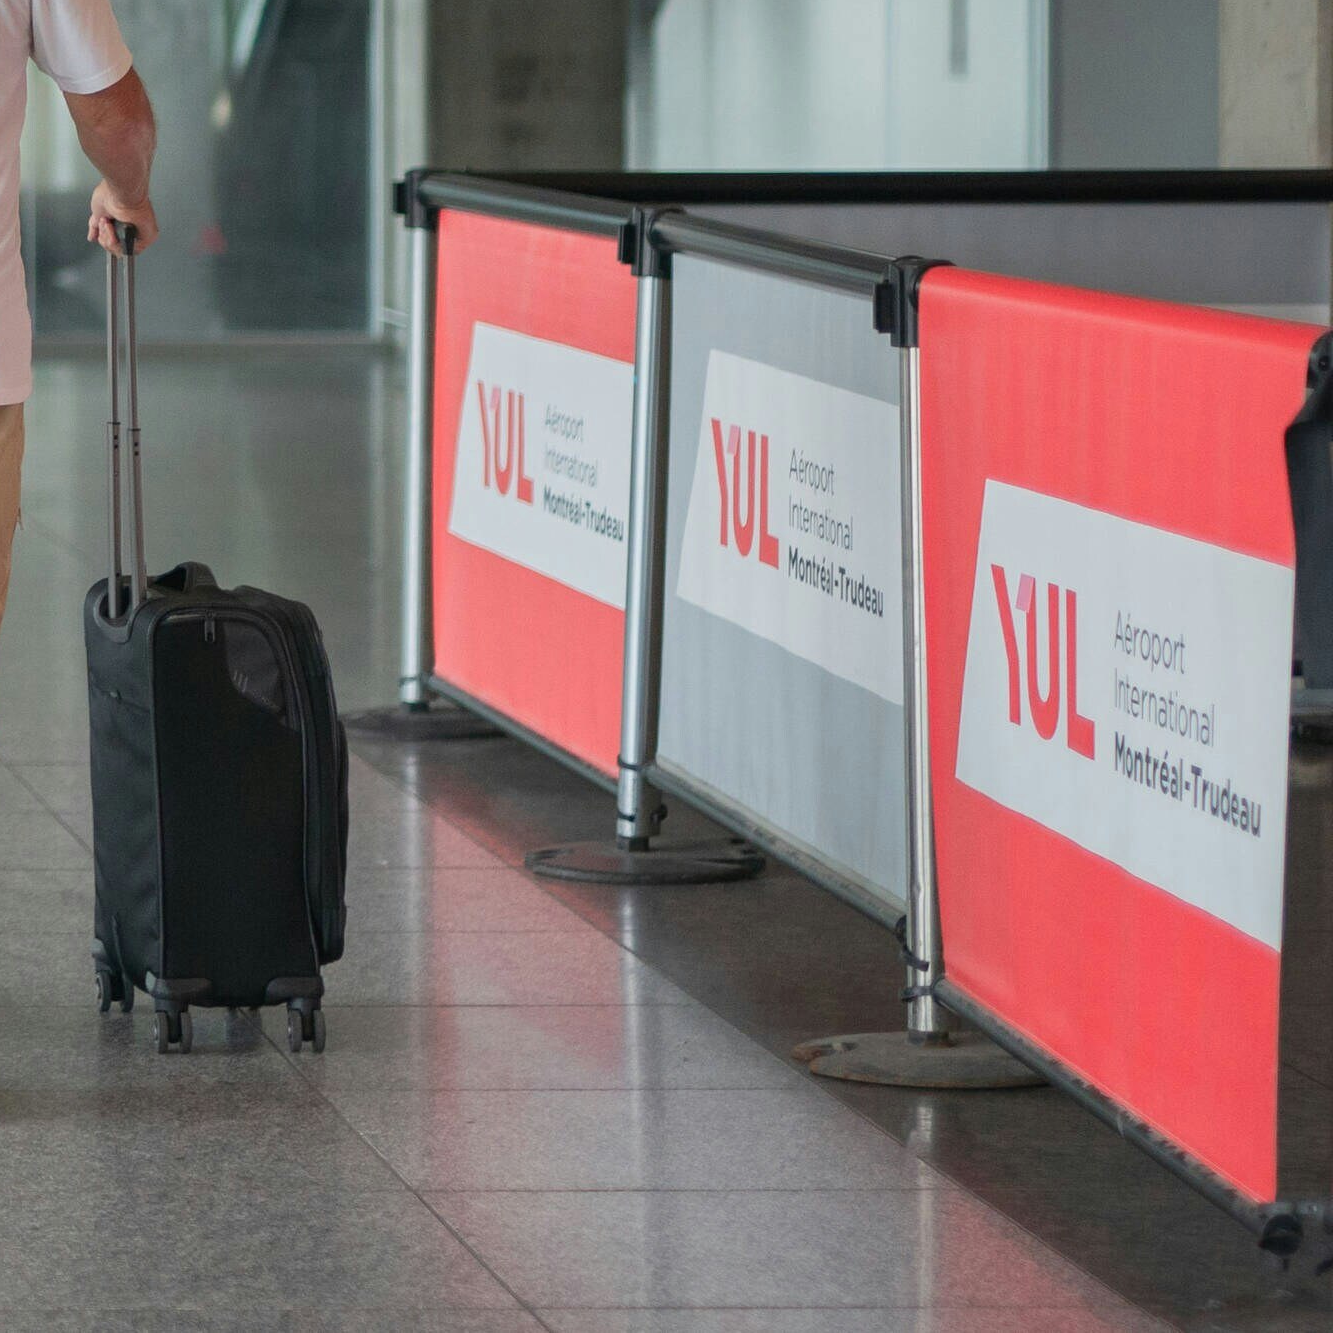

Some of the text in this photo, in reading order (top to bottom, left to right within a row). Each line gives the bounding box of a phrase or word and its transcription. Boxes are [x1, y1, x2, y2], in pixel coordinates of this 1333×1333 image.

[477, 380, 534, 505] YUL
[789, 448, 835, 496] Aéroport
[543, 484, 625, 543] Montréal-Trudeau
[711, 418, 780, 570] YUL
[789, 495, 854, 552] International
[788, 545, 884, 618] Montréal-Trudeau
[991, 563, 1095, 761] YUL
[1113, 610, 1186, 675] Aéroport
[1115, 668, 1215, 748] International
[1114, 730, 1262, 838] Montréal-Trudeau
